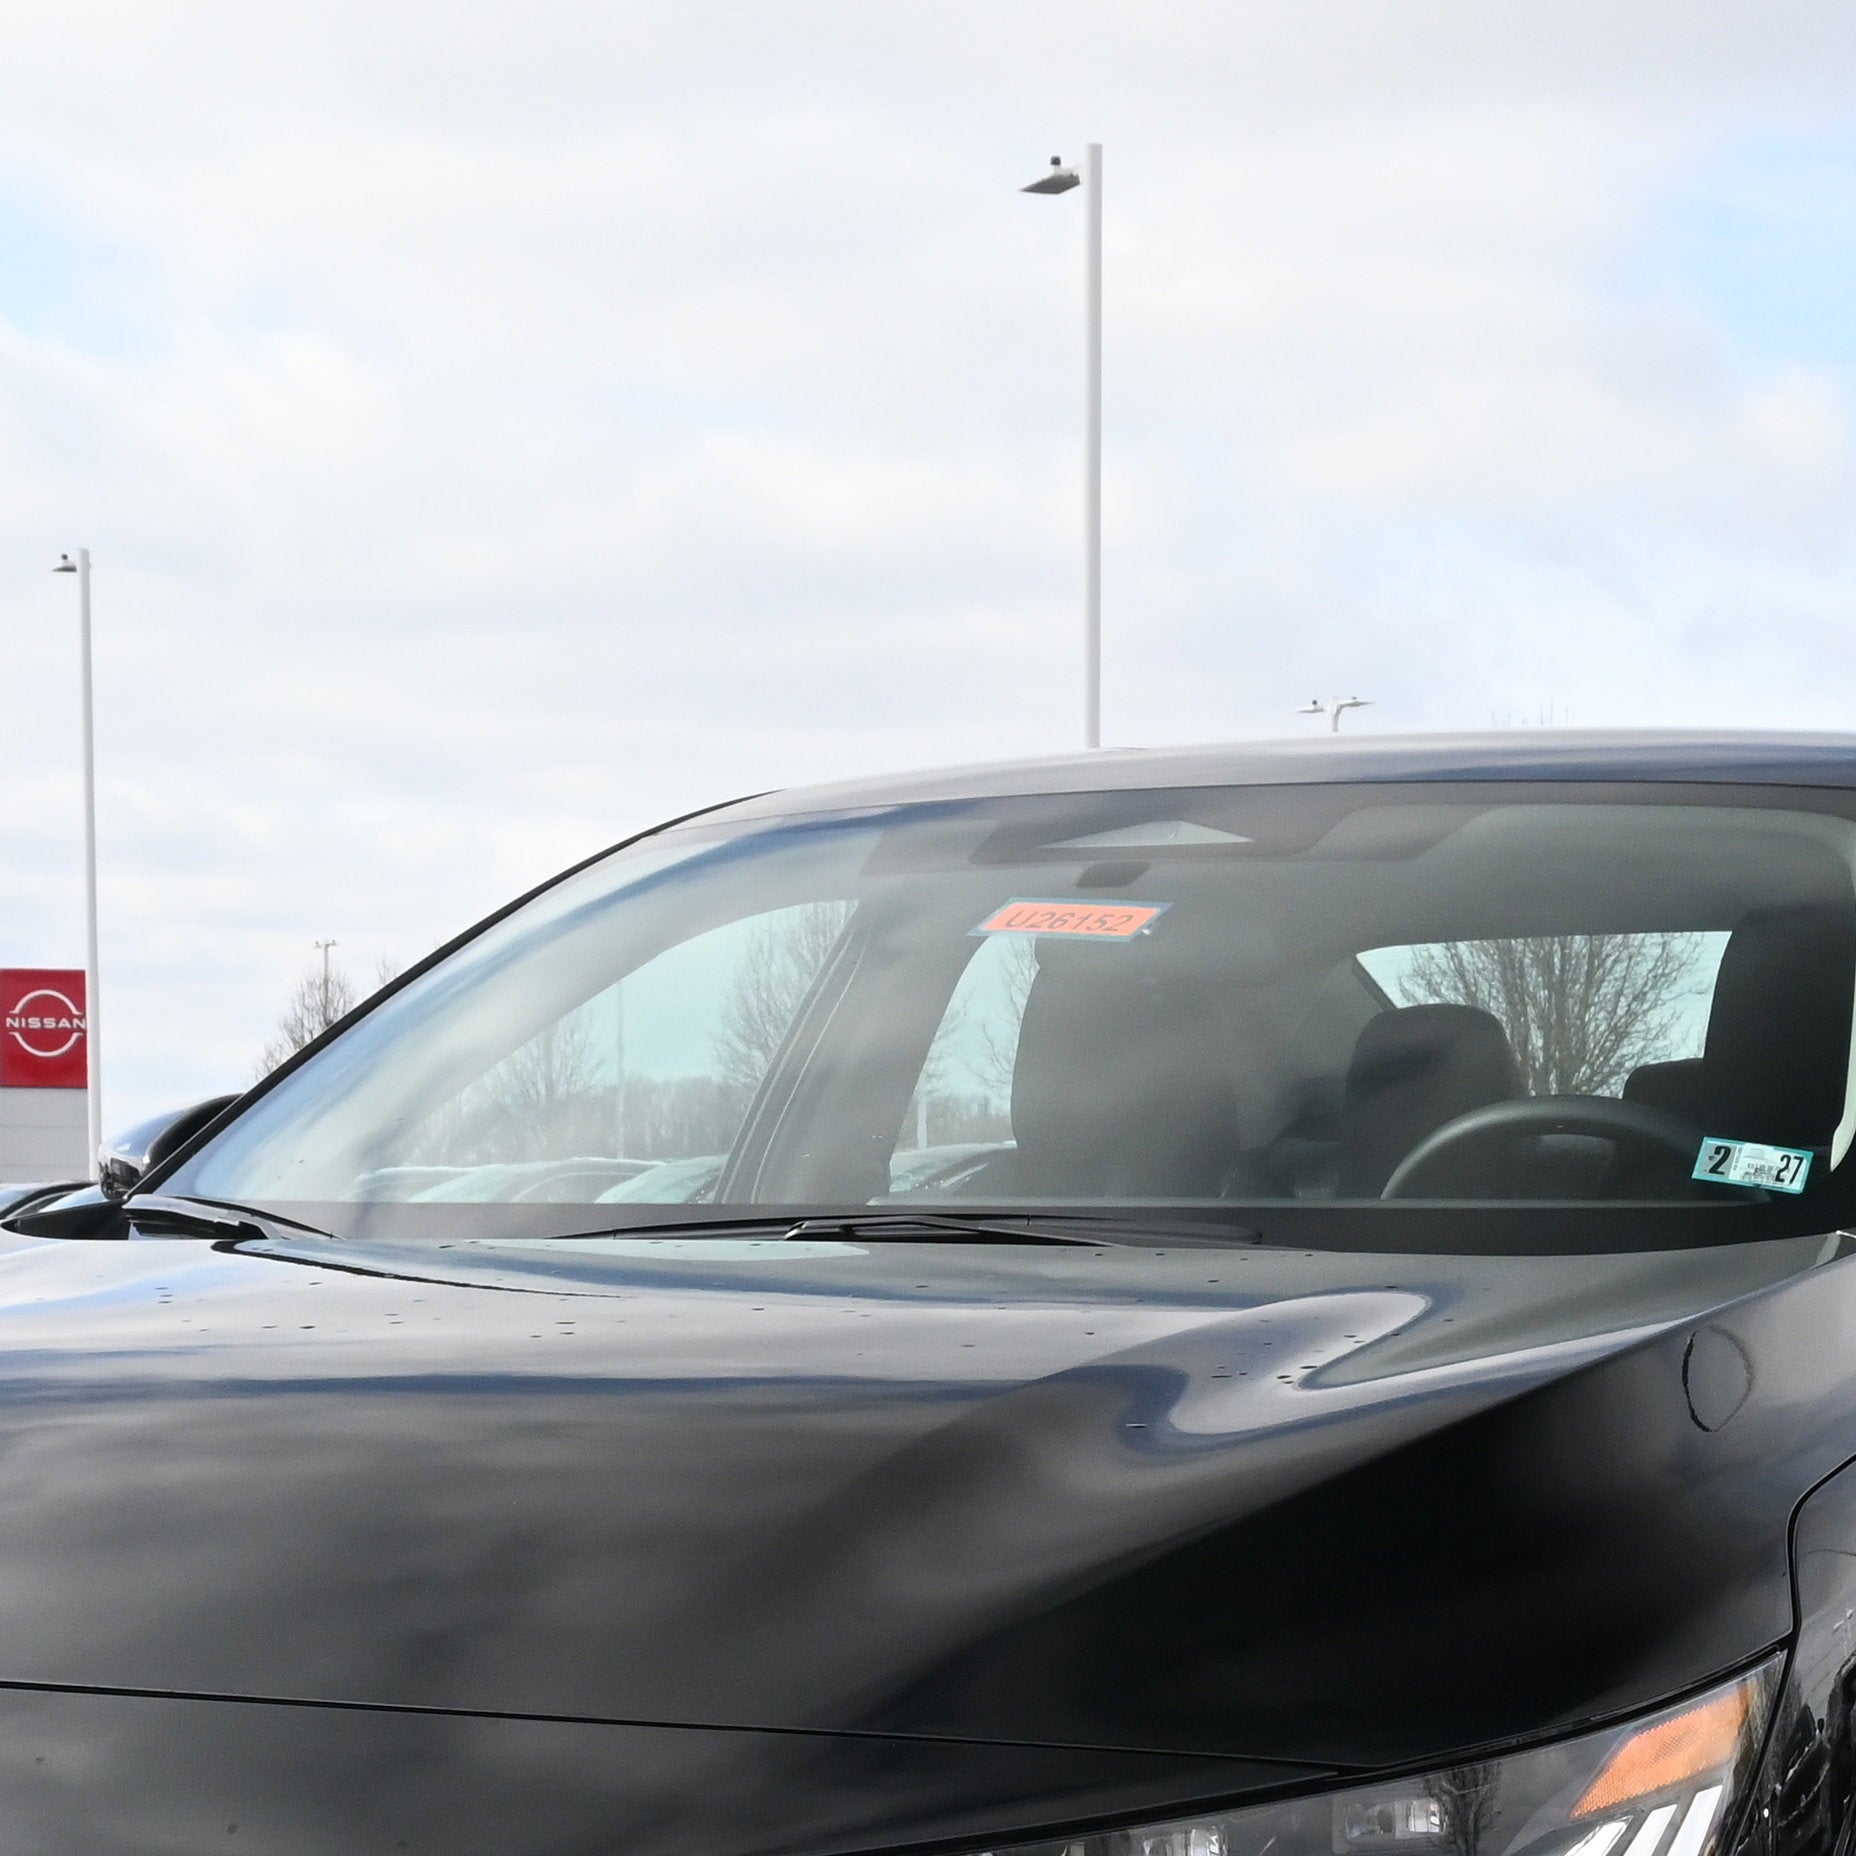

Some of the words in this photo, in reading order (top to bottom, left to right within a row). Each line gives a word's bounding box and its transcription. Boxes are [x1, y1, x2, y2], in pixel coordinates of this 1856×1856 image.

[1004, 910, 1134, 932] U26152
[5, 1017, 87, 1029] NISSAN
[1708, 1145, 1732, 1175] 2
[1775, 1154, 1805, 1185] 27
